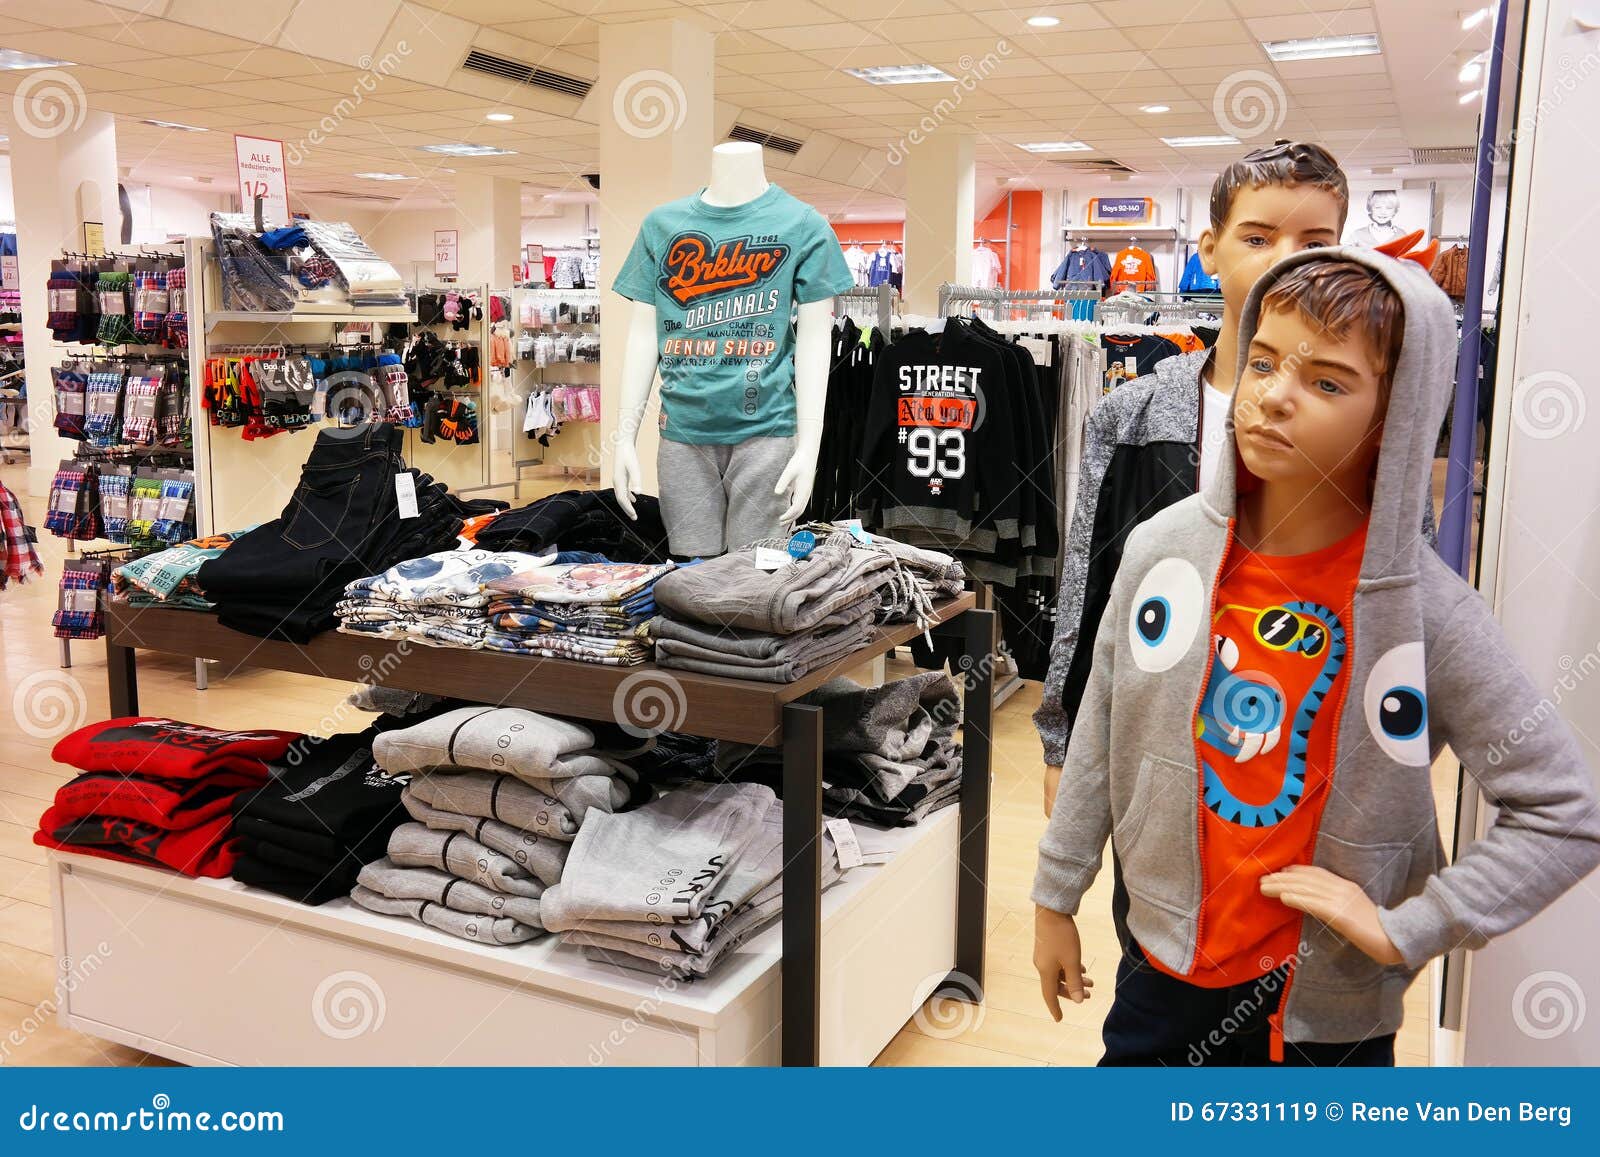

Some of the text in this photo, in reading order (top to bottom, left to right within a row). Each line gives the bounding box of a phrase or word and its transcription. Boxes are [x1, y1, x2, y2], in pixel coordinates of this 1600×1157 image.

[250, 153, 271, 164] ALLE
[244, 180, 269, 199] 1/2
[1102, 205, 1118, 213] Boys
[756, 234, 779, 244] 1961
[685, 289, 779, 329] ORIGINALS
[664, 319, 682, 332] The
[664, 339, 776, 356] DENIM SHOP
[719, 357, 742, 366] NEW
[899, 365, 982, 394] STREET
[921, 390, 955, 398] GENERATION
